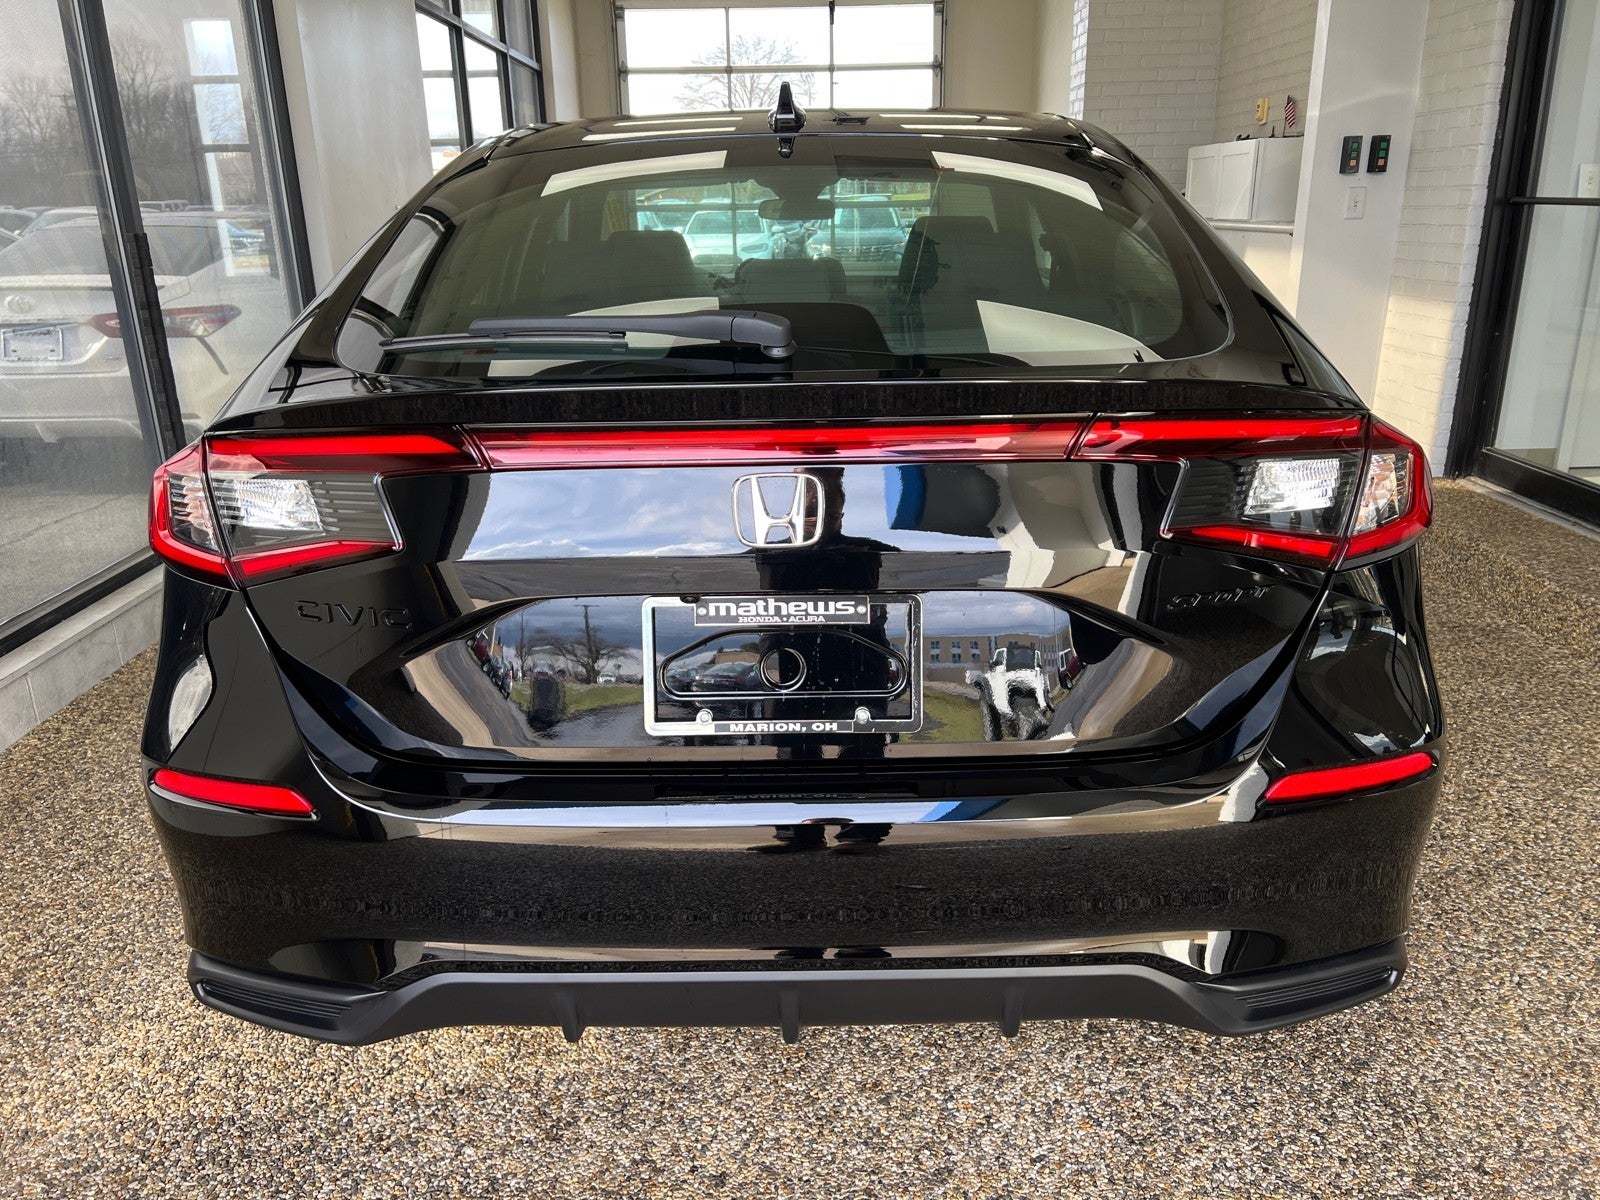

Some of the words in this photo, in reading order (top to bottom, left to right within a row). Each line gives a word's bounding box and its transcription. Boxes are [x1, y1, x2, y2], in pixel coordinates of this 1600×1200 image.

[296, 600, 412, 628] CIVIC
[708, 598, 855, 616] mathews
[737, 616, 782, 624] HONDA
[788, 615, 826, 623] ACURA
[729, 722, 807, 733] MARION,
[811, 722, 838, 732] OH
